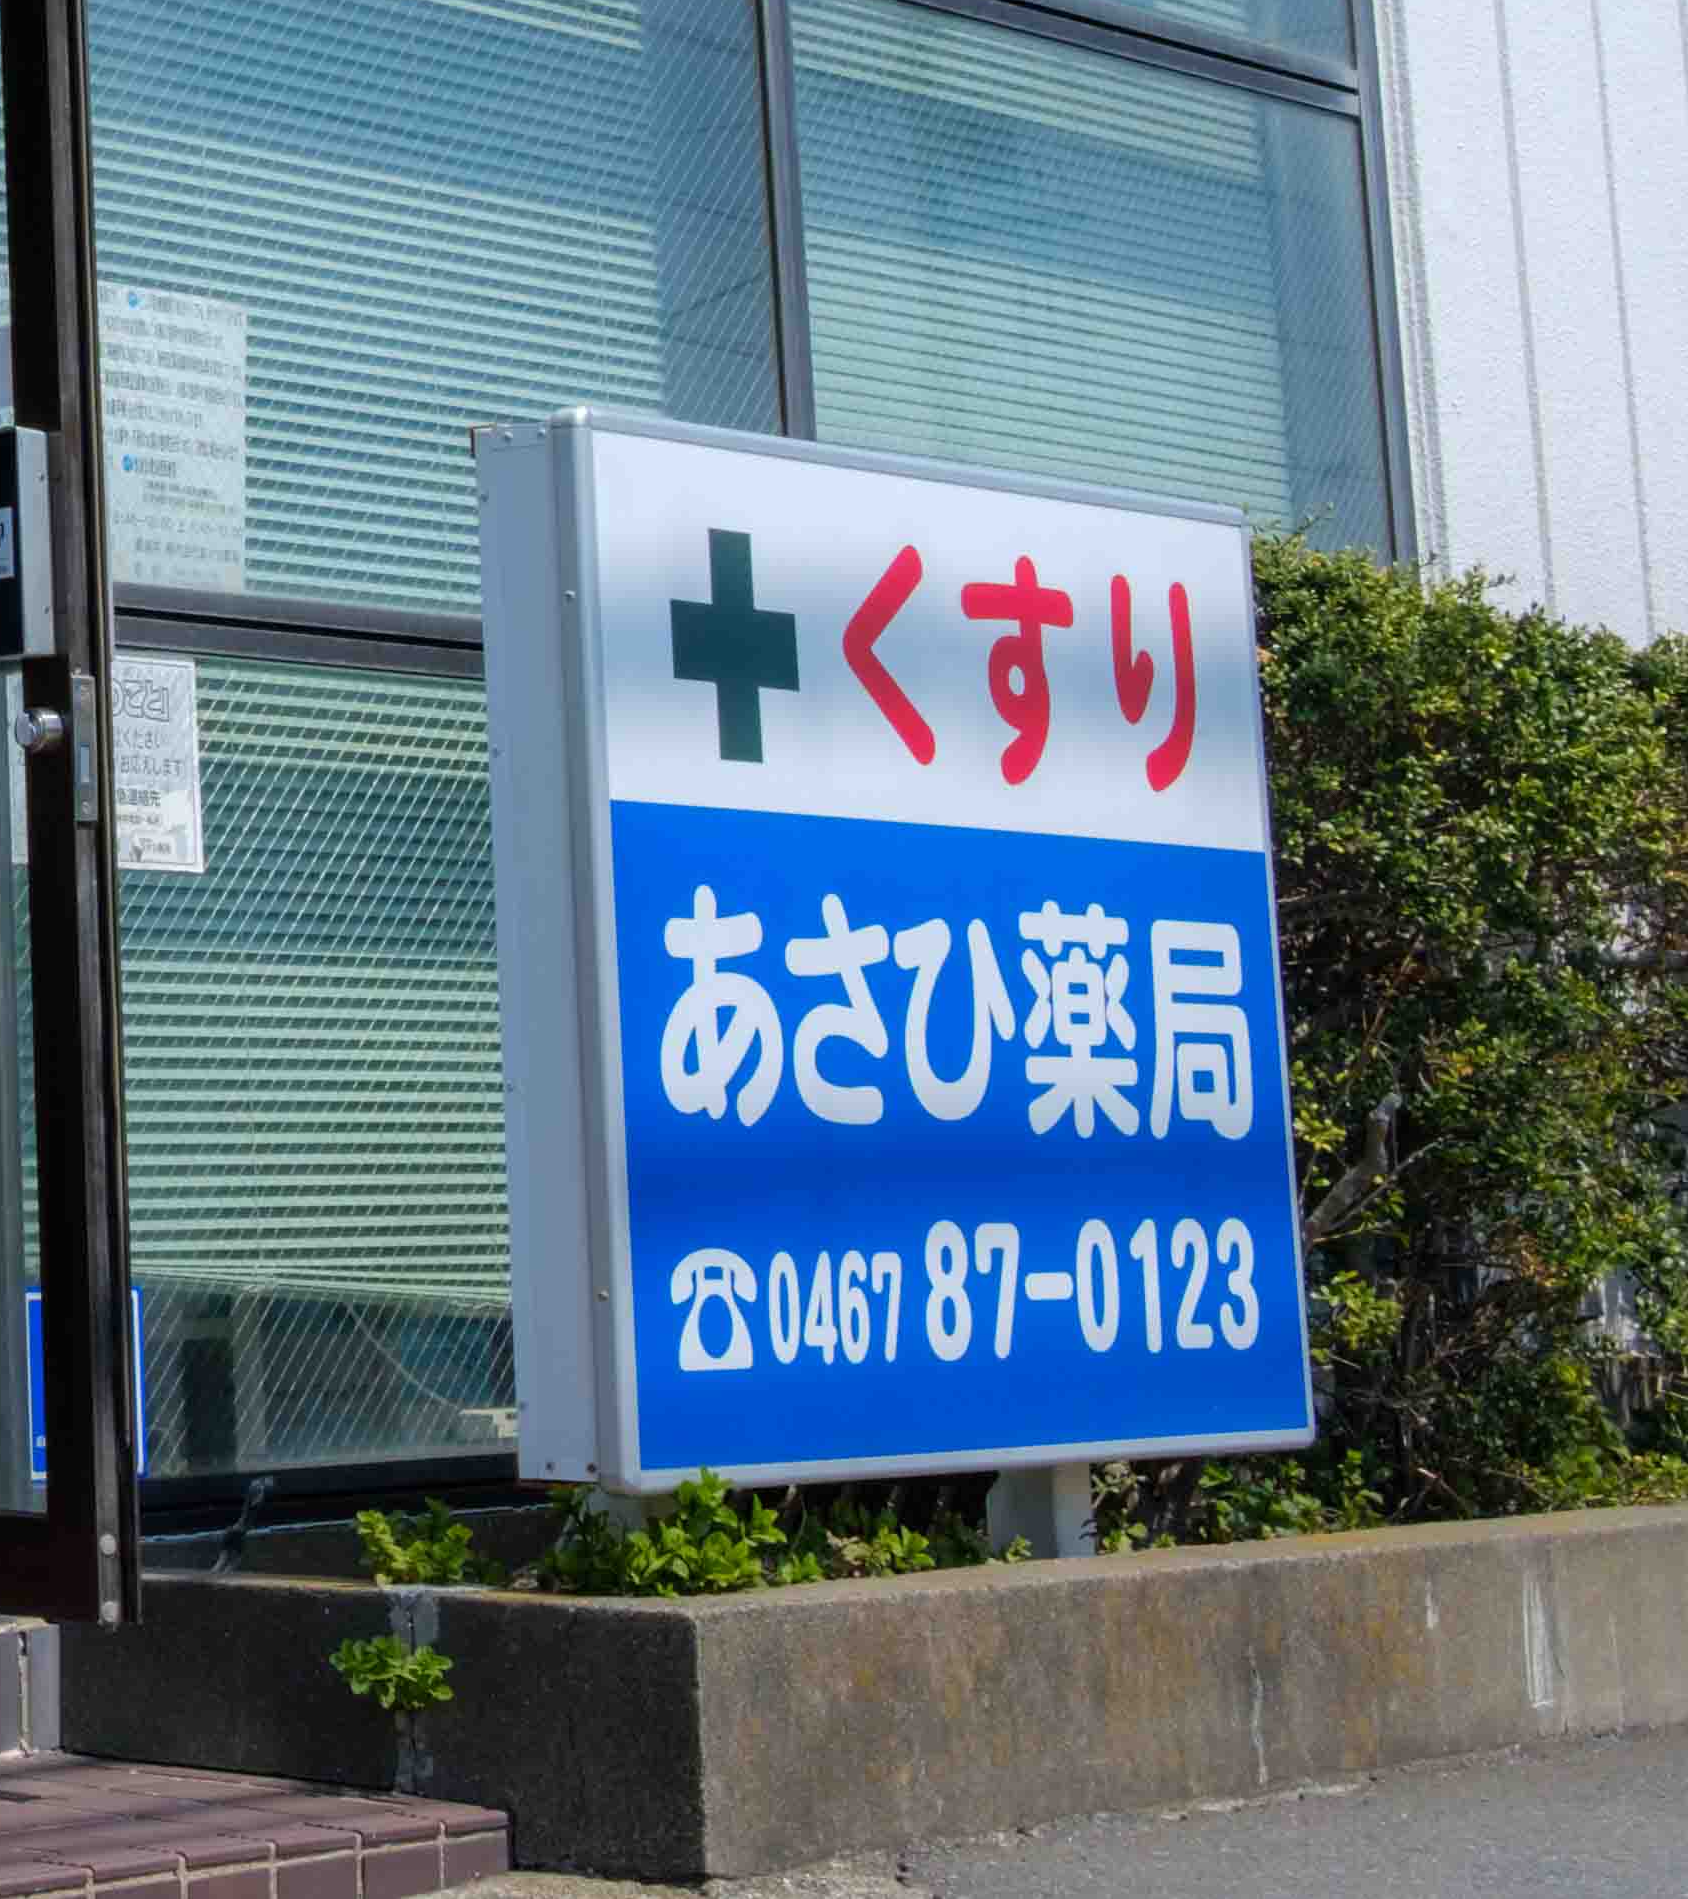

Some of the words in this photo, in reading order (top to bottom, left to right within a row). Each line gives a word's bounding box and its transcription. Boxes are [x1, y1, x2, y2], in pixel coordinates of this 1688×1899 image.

[842, 544, 1196, 792] くすり
[660, 885, 1253, 1140] あさひ薬局
[769, 1247, 903, 1365] 0467
[925, 1217, 1260, 1362] 87-0123
